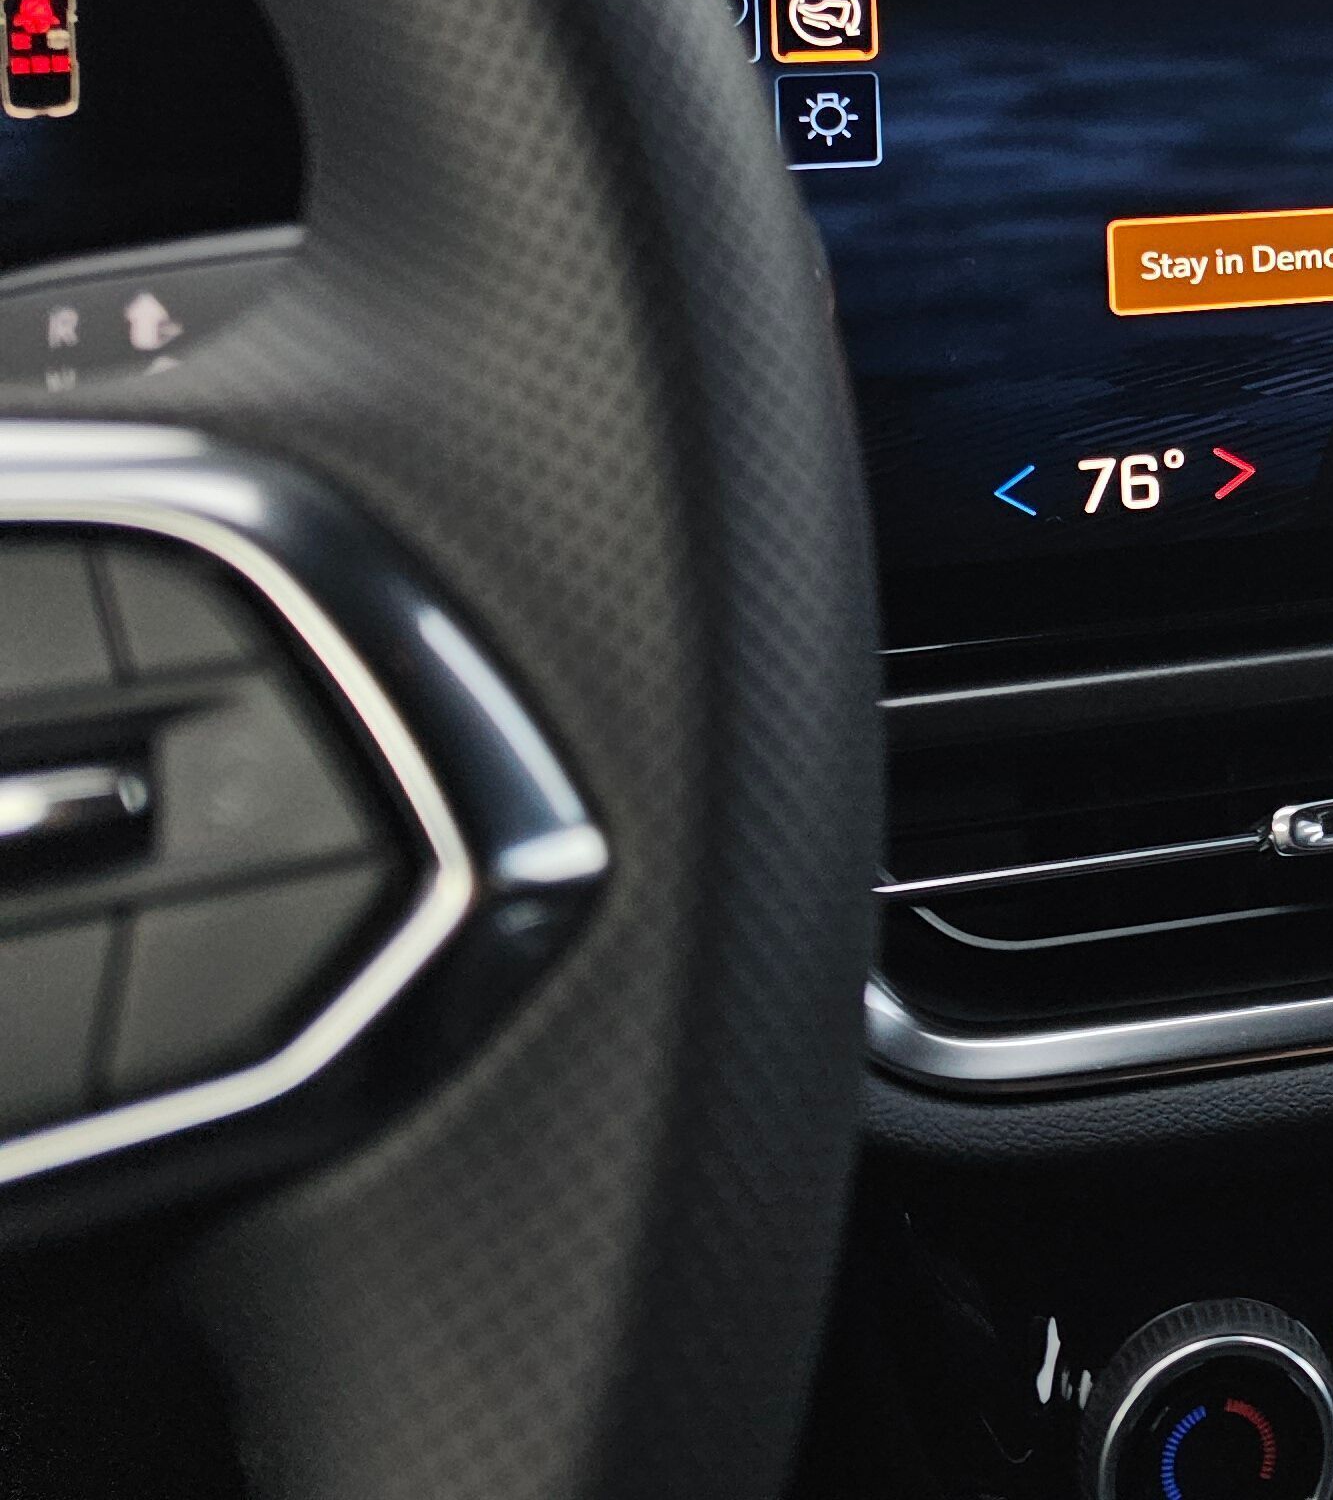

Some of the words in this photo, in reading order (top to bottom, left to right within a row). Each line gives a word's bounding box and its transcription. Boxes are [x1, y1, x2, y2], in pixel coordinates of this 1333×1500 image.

[1140, 250, 1209, 285] Stay
[1215, 248, 1244, 275] in
[1077, 448, 1185, 514] 76°
